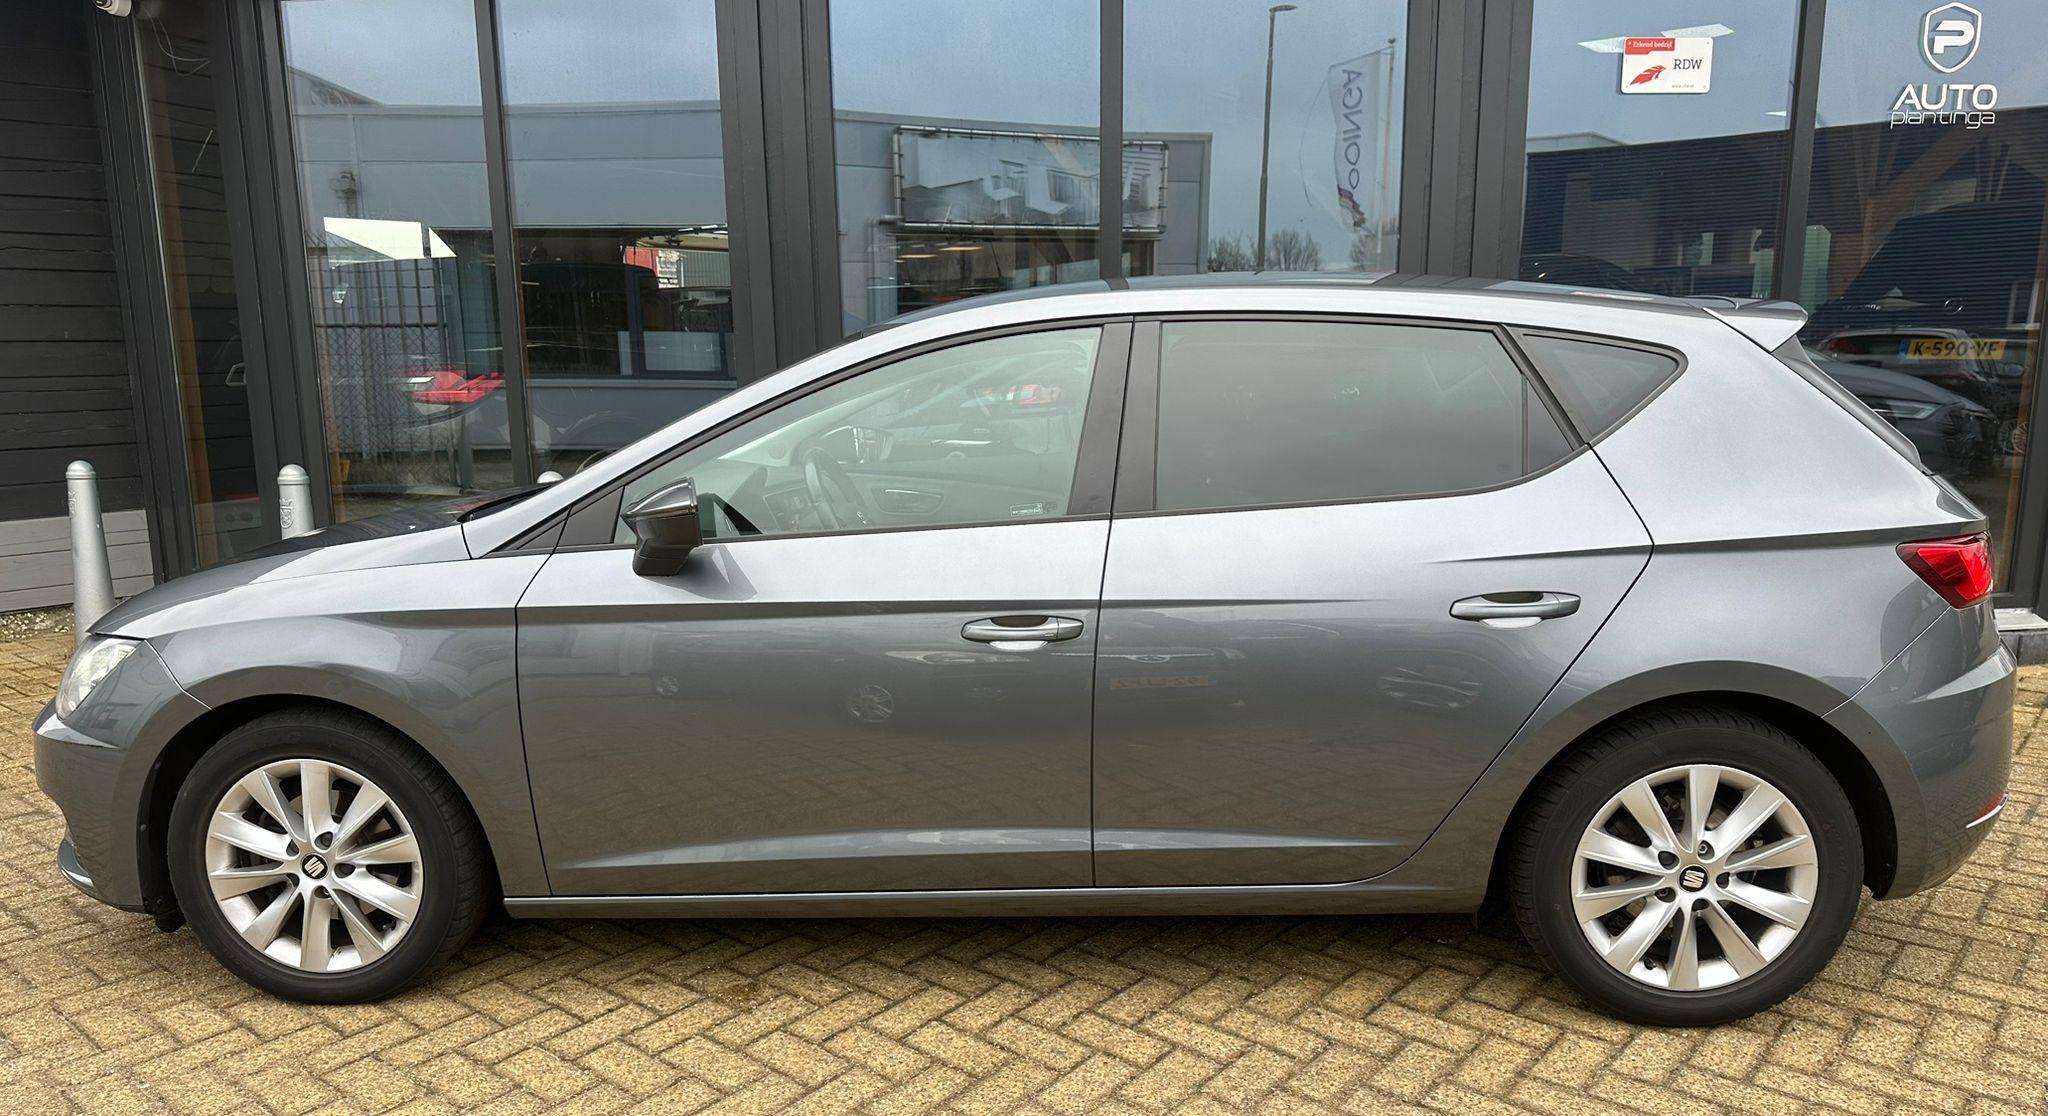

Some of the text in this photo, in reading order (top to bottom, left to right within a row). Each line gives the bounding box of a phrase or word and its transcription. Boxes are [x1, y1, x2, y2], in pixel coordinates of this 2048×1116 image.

[1673, 59, 1702, 70] RDW
[1892, 83, 1998, 110] AUTO
[1890, 109, 1996, 129] plantinga
[1913, 340, 2000, 356] K-590-VF
